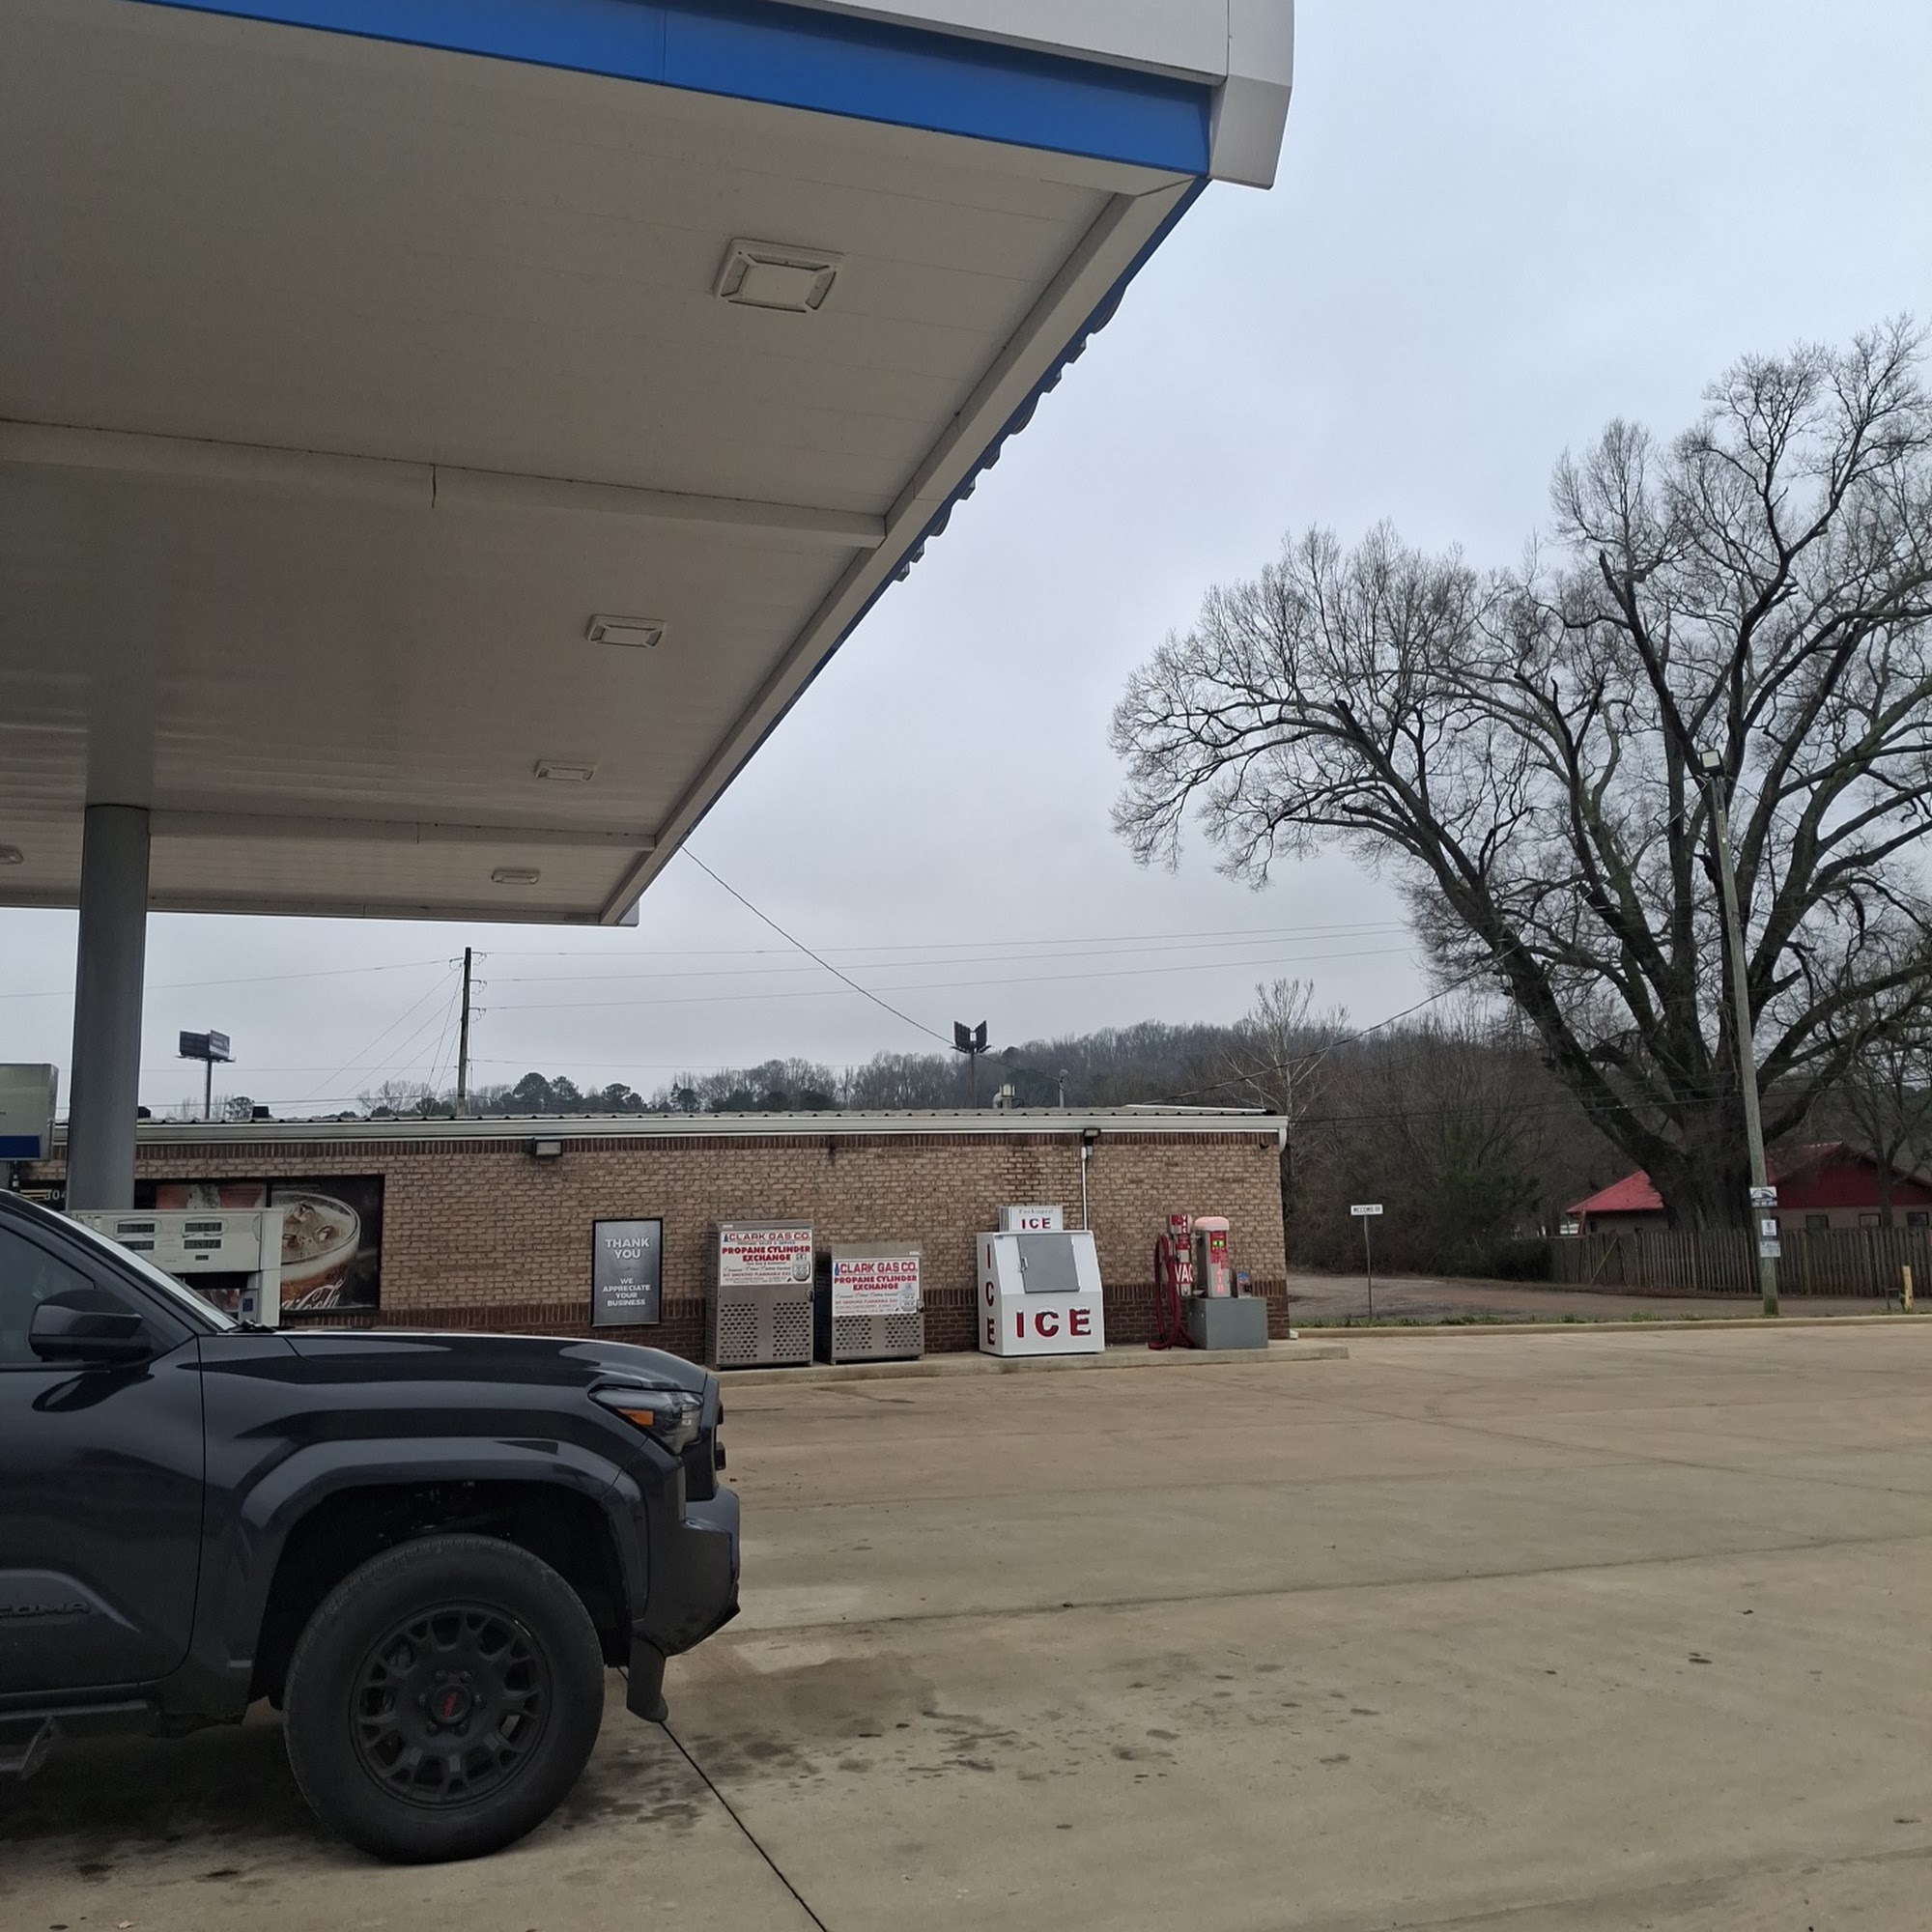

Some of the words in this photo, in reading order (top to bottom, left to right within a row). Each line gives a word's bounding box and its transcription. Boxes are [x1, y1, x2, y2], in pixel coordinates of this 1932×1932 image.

[1022, 1217, 1051, 1229] ICE
[729, 1233, 765, 1241] CLARK
[768, 1232, 792, 1240] GAS
[605, 1237, 650, 1248] THANK
[614, 1249, 640, 1259] YOU
[840, 1263, 874, 1273] CLARK
[877, 1262, 899, 1272] GAS
[603, 1284, 651, 1293] APPRECIATE
[985, 1243, 995, 1346] ICE
[1015, 1307, 1092, 1338] ICE
